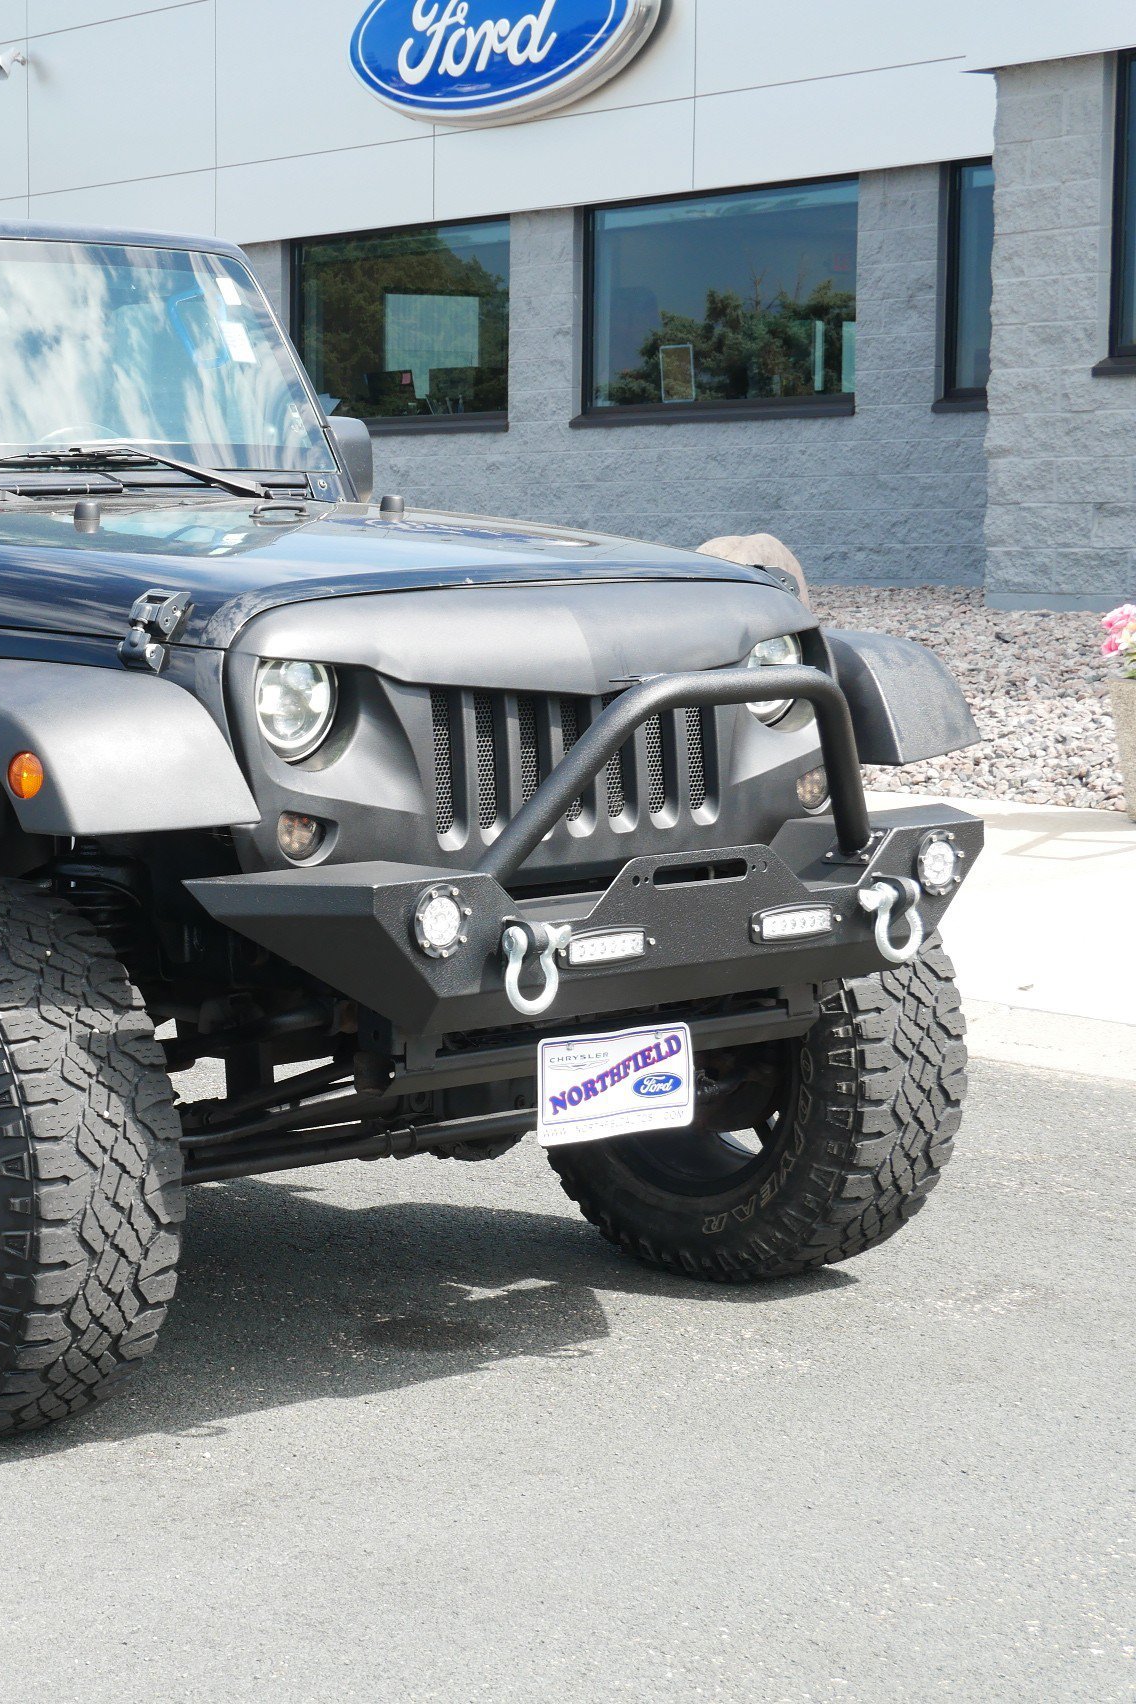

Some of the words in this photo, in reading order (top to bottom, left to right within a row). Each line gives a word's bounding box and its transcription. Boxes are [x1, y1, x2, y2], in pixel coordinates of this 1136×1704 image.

[397, 0, 557, 85] Ford
[548, 1034, 682, 1115] NORTHFIELD
[549, 1052, 609, 1064] CHRYSLER
[640, 1075, 672, 1094] Ford
